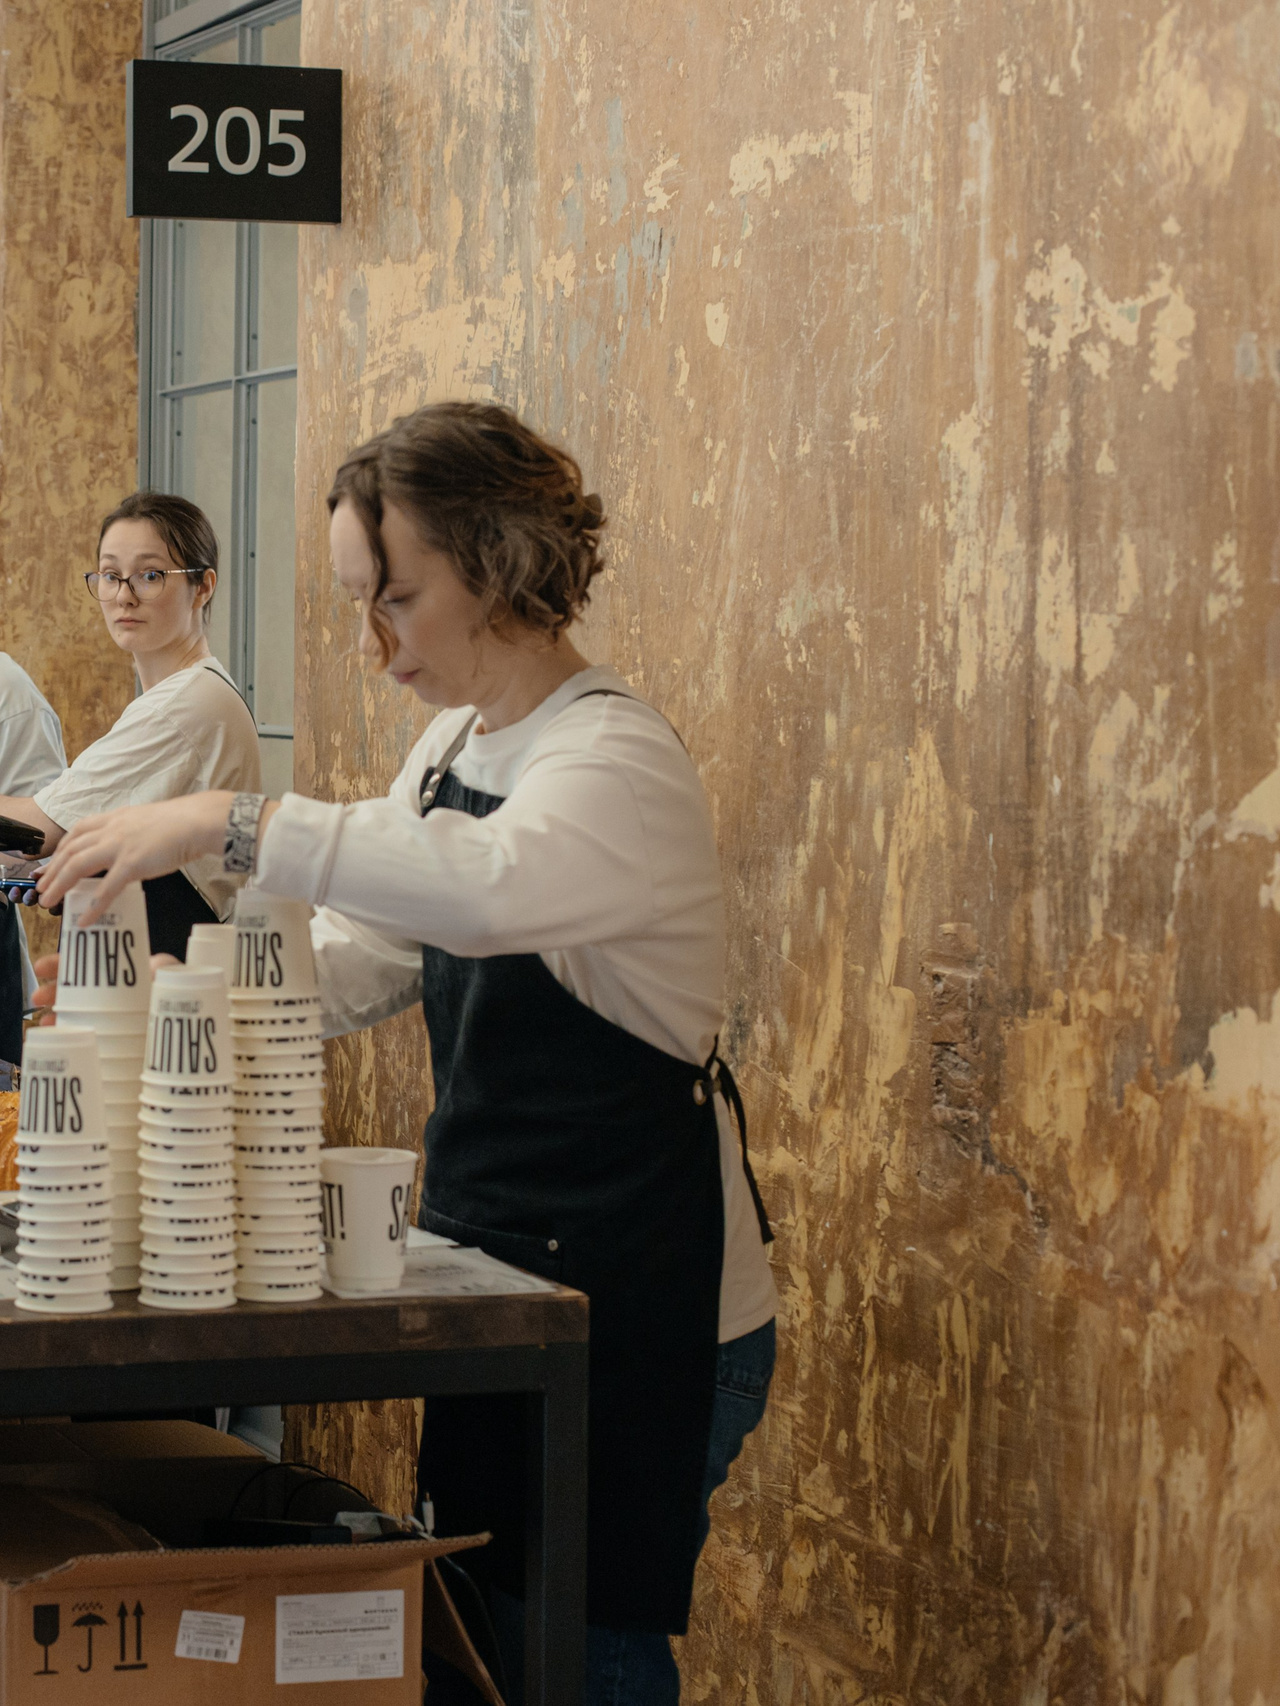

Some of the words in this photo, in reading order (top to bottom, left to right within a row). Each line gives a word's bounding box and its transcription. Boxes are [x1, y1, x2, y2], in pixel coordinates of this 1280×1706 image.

[167, 104, 307, 177] 205
[60, 930, 137, 988] SALUT
[147, 1016, 217, 1075] SALUT
